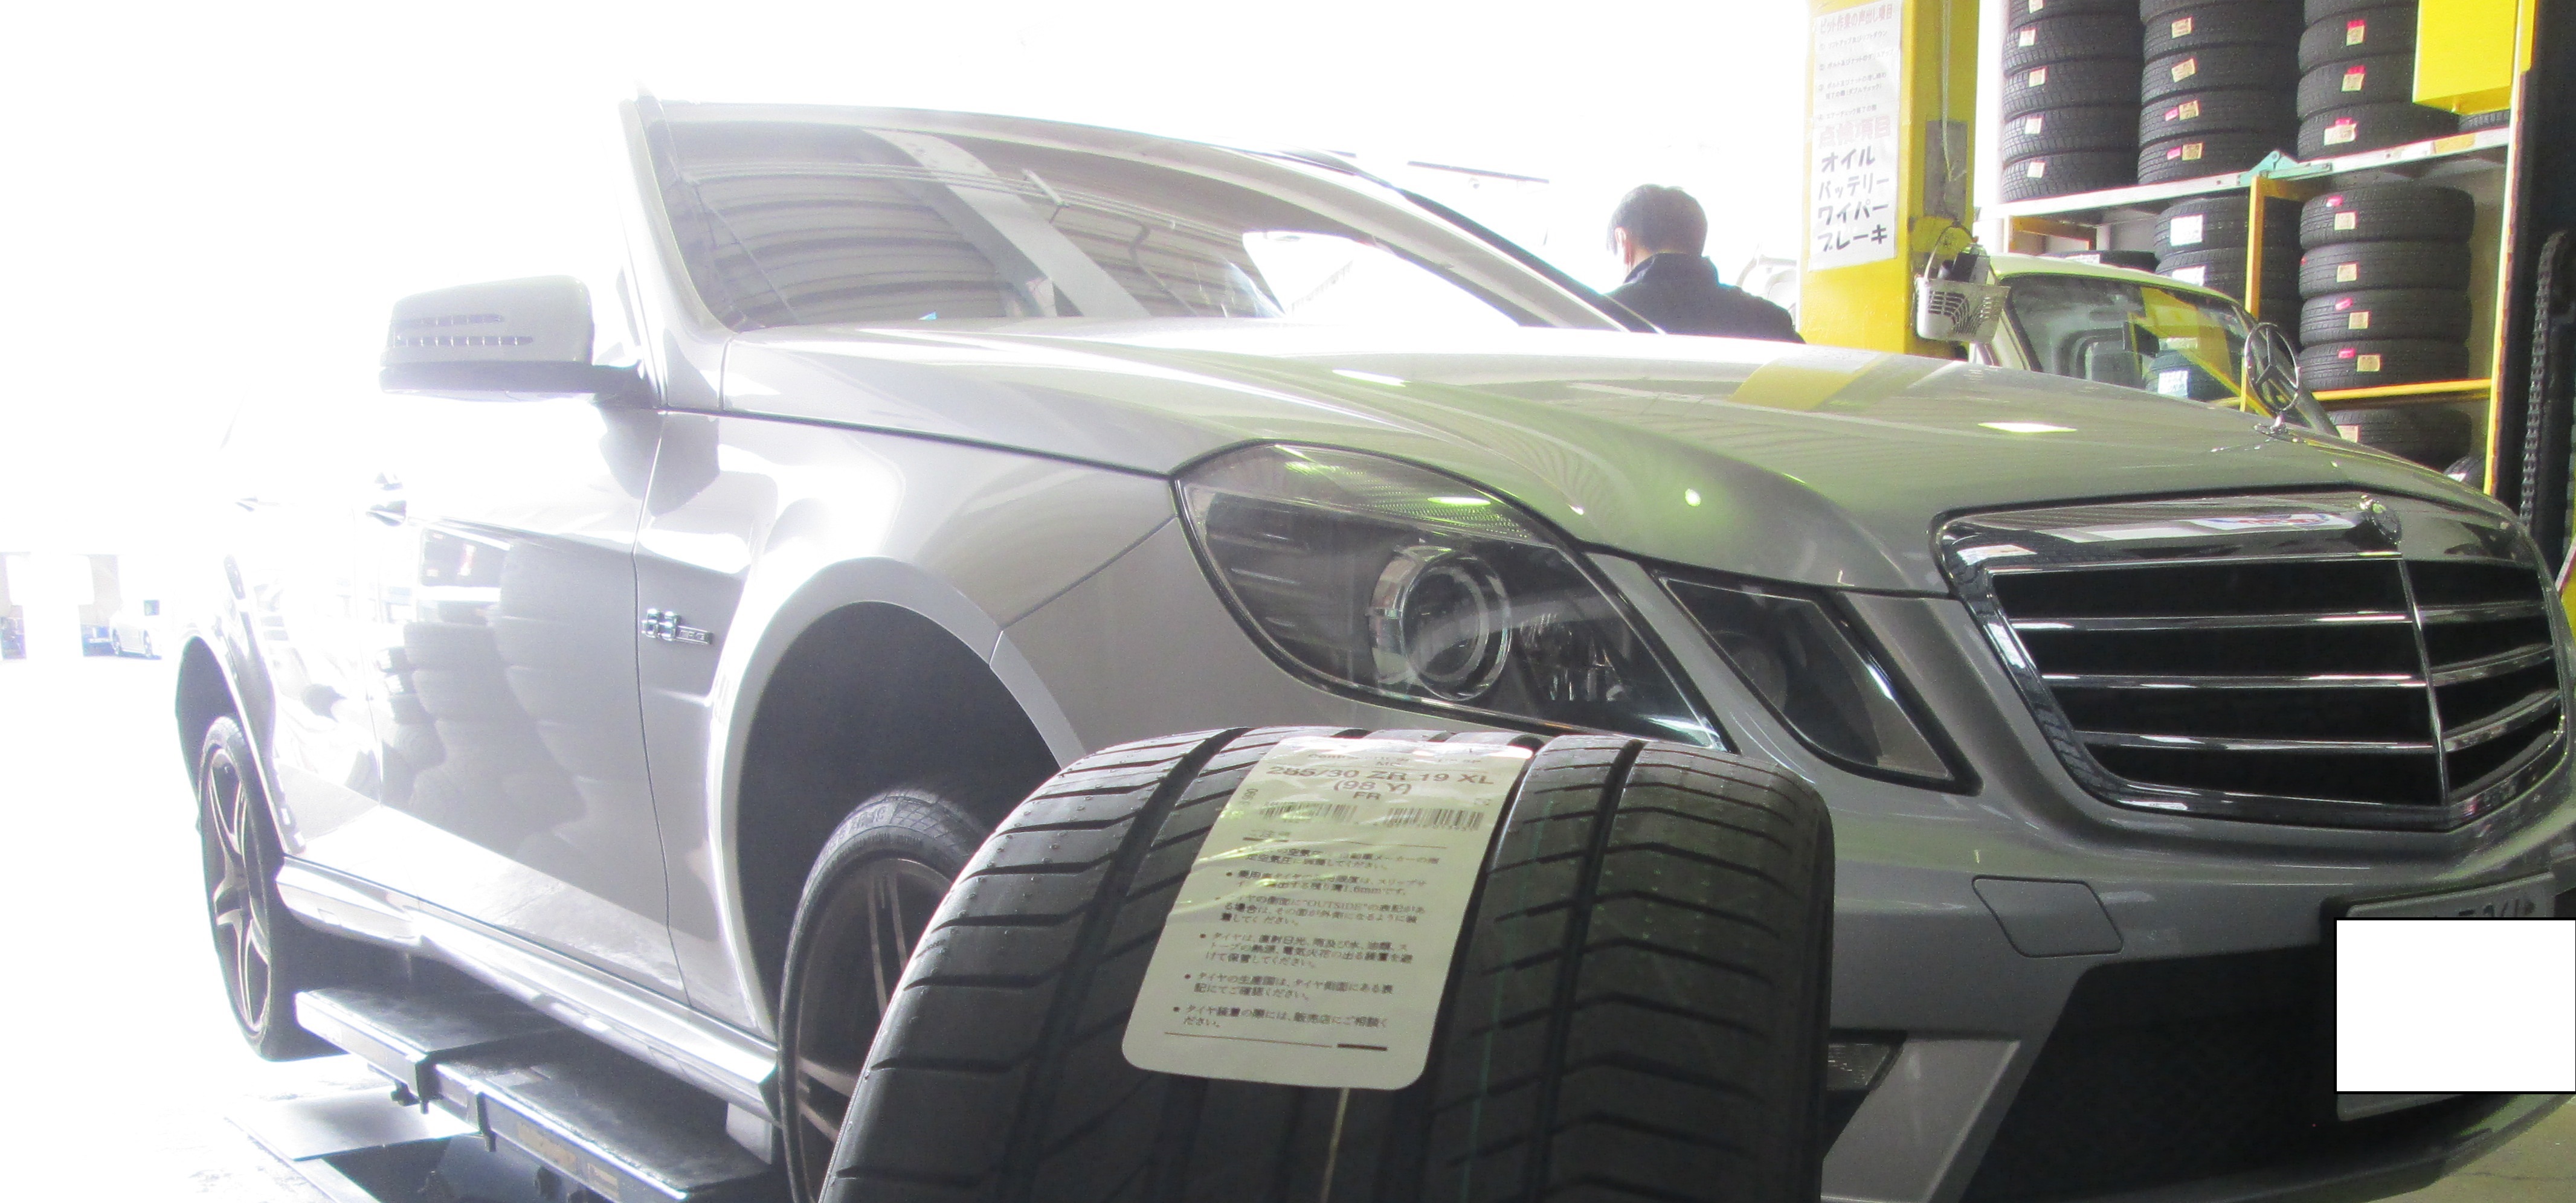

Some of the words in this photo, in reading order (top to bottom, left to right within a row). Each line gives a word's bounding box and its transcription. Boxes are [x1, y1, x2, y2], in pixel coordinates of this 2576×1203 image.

[1818, 115, 1891, 148] 点検項目
[1821, 146, 1875, 172] オイル
[1818, 173, 1889, 200] バッテリー
[1818, 199, 1889, 225] ワイパー
[1817, 224, 1888, 252] ブレーキ
[1269, 766, 1360, 778] 285/30
[1368, 771, 1407, 781] ZR
[1457, 774, 1495, 784] XL
[1333, 780, 1376, 791] (98
[1353, 791, 1382, 800] FR
